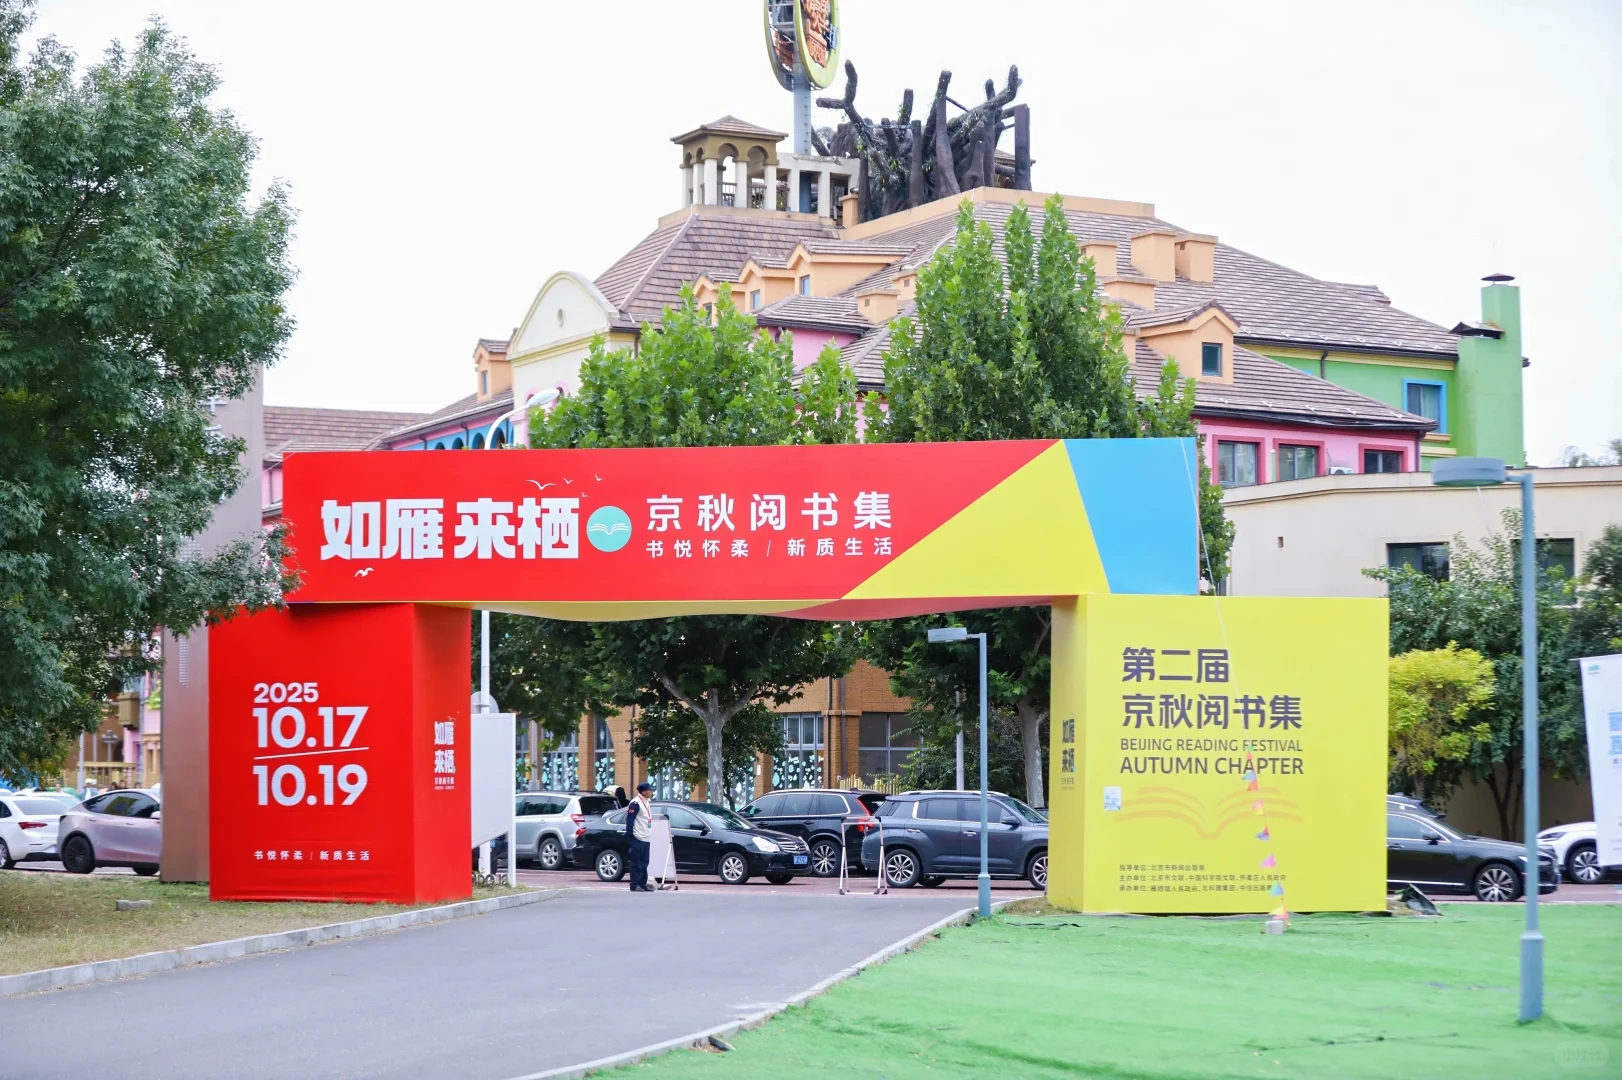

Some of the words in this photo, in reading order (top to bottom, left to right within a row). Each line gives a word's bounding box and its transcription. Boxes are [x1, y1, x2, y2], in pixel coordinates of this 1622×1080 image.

[646, 491, 892, 532] 京秋阅书集
[646, 540, 749, 559] 书悦怀柔
[787, 537, 893, 557] 新质生活
[1122, 646, 1229, 684] 第二届
[253, 682, 319, 704] 2025
[1122, 693, 1303, 730] 京秋阅书集
[252, 706, 369, 748] 10.17
[1120, 738, 1172, 752] BEIJING
[1176, 738, 1238, 752] READING
[1242, 738, 1303, 752] FESTIVAL
[1119, 756, 1208, 775] AUTUMN
[1214, 756, 1304, 775] CHAPTER
[252, 764, 369, 807] 10.19
[254, 850, 303, 861] 书悦怀柔
[319, 850, 370, 861] 新质生活
